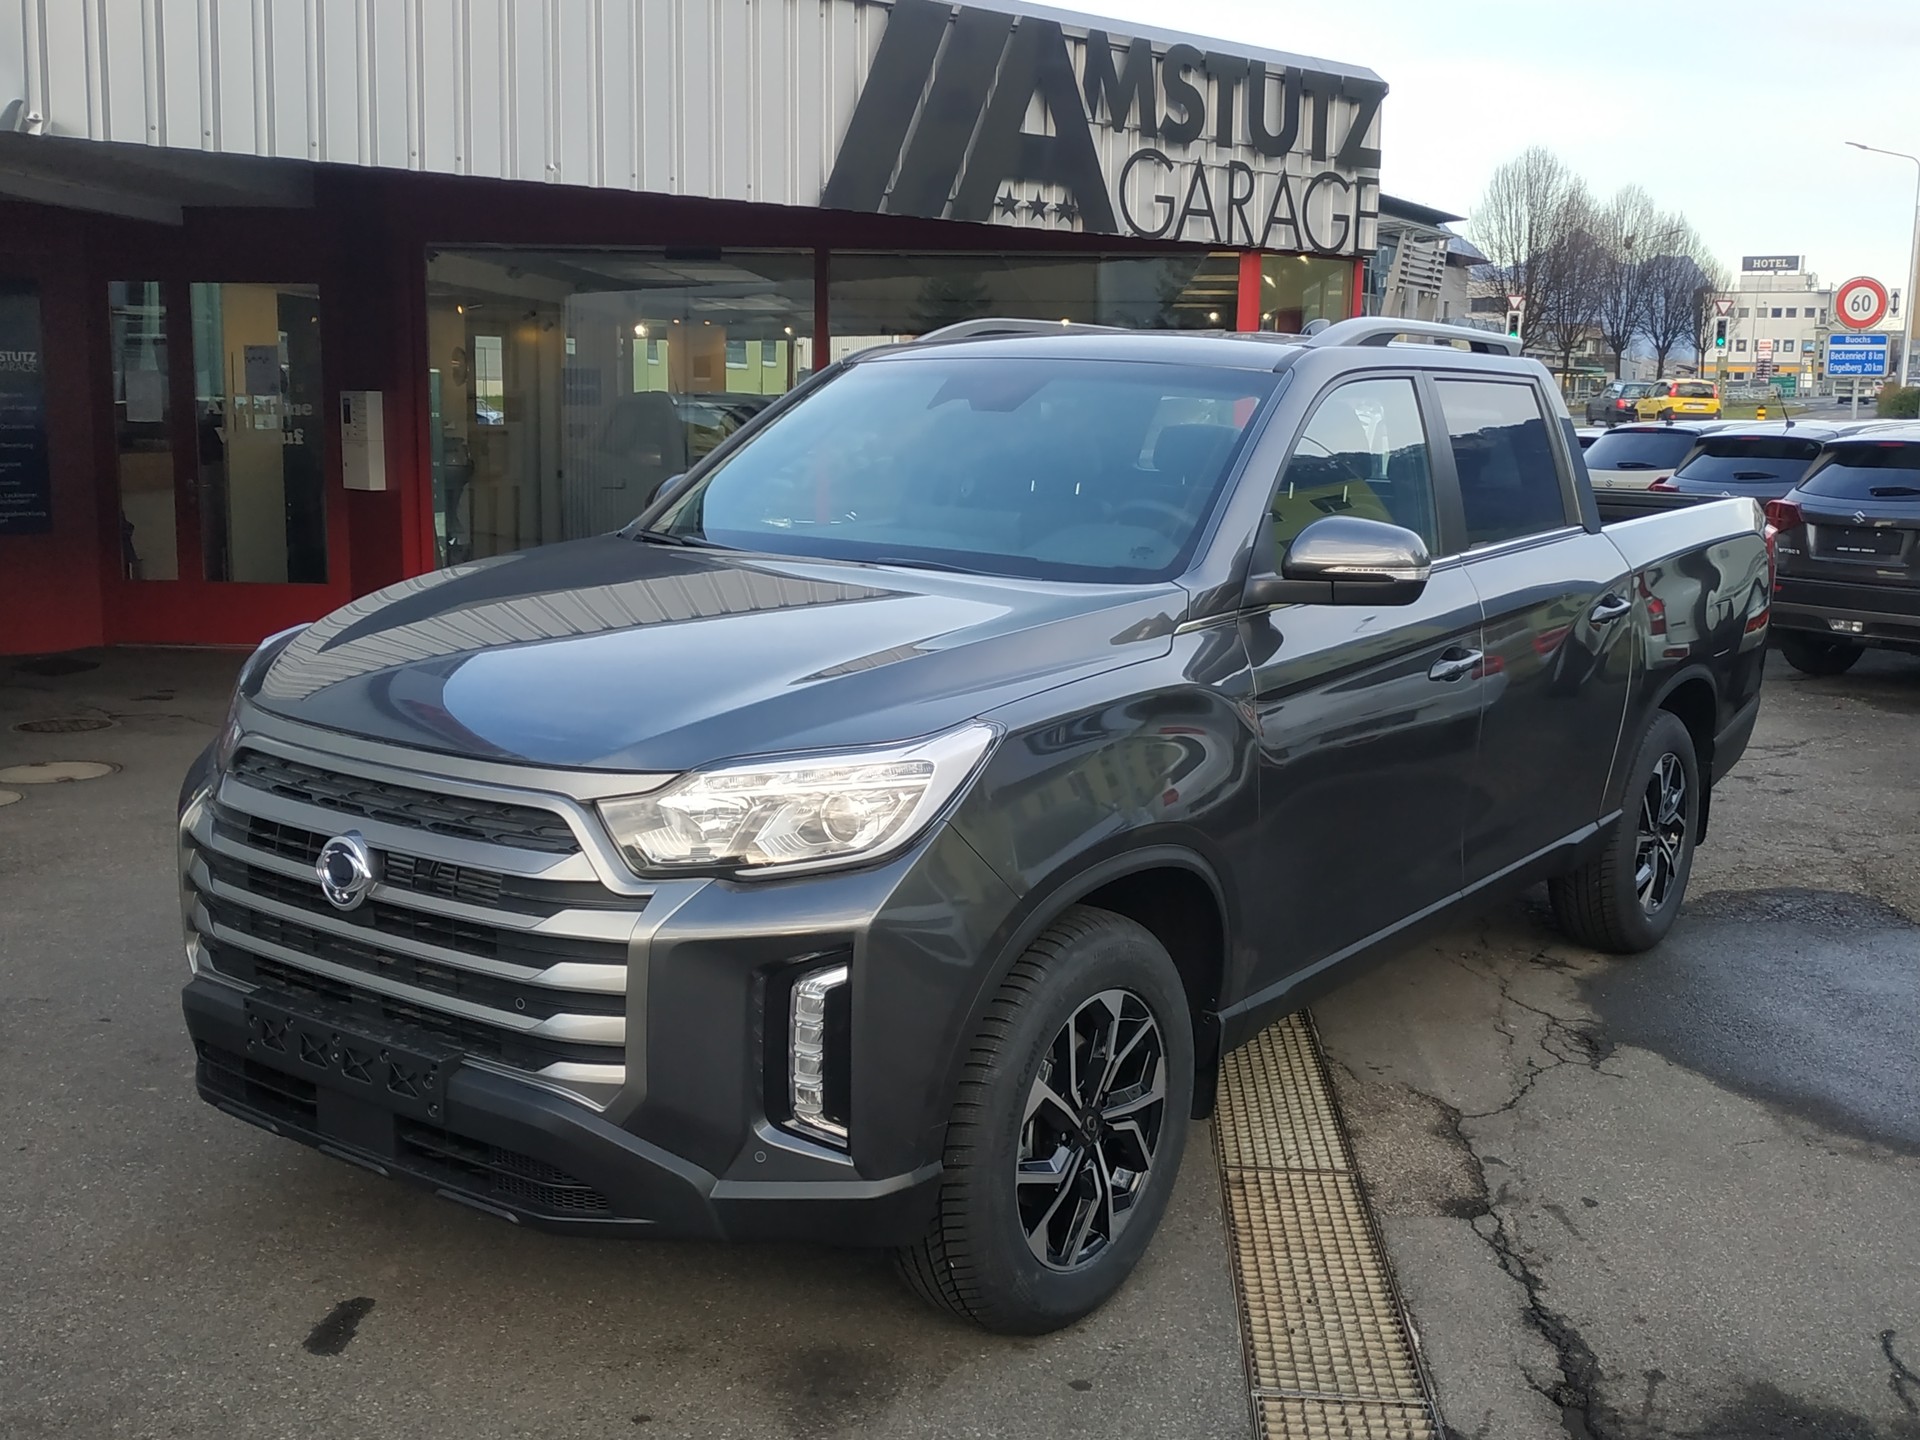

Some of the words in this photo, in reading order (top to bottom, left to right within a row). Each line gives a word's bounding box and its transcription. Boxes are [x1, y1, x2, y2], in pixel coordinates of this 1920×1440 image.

[940, 15, 1390, 234] AMSTUTZ
[1118, 147, 1381, 257] GARAGE
[1752, 258, 1789, 269] HOTEL
[1851, 294, 1871, 313] 60
[1845, 336, 1871, 344] Buochs
[1830, 351, 1867, 361] Beckenried
[1867, 351, 1873, 361] 8
[1873, 351, 1884, 361] km
[1829, 362, 1862, 374] Engelberg
[1863, 362, 1873, 372] 20
[1873, 362, 1884, 372] km
